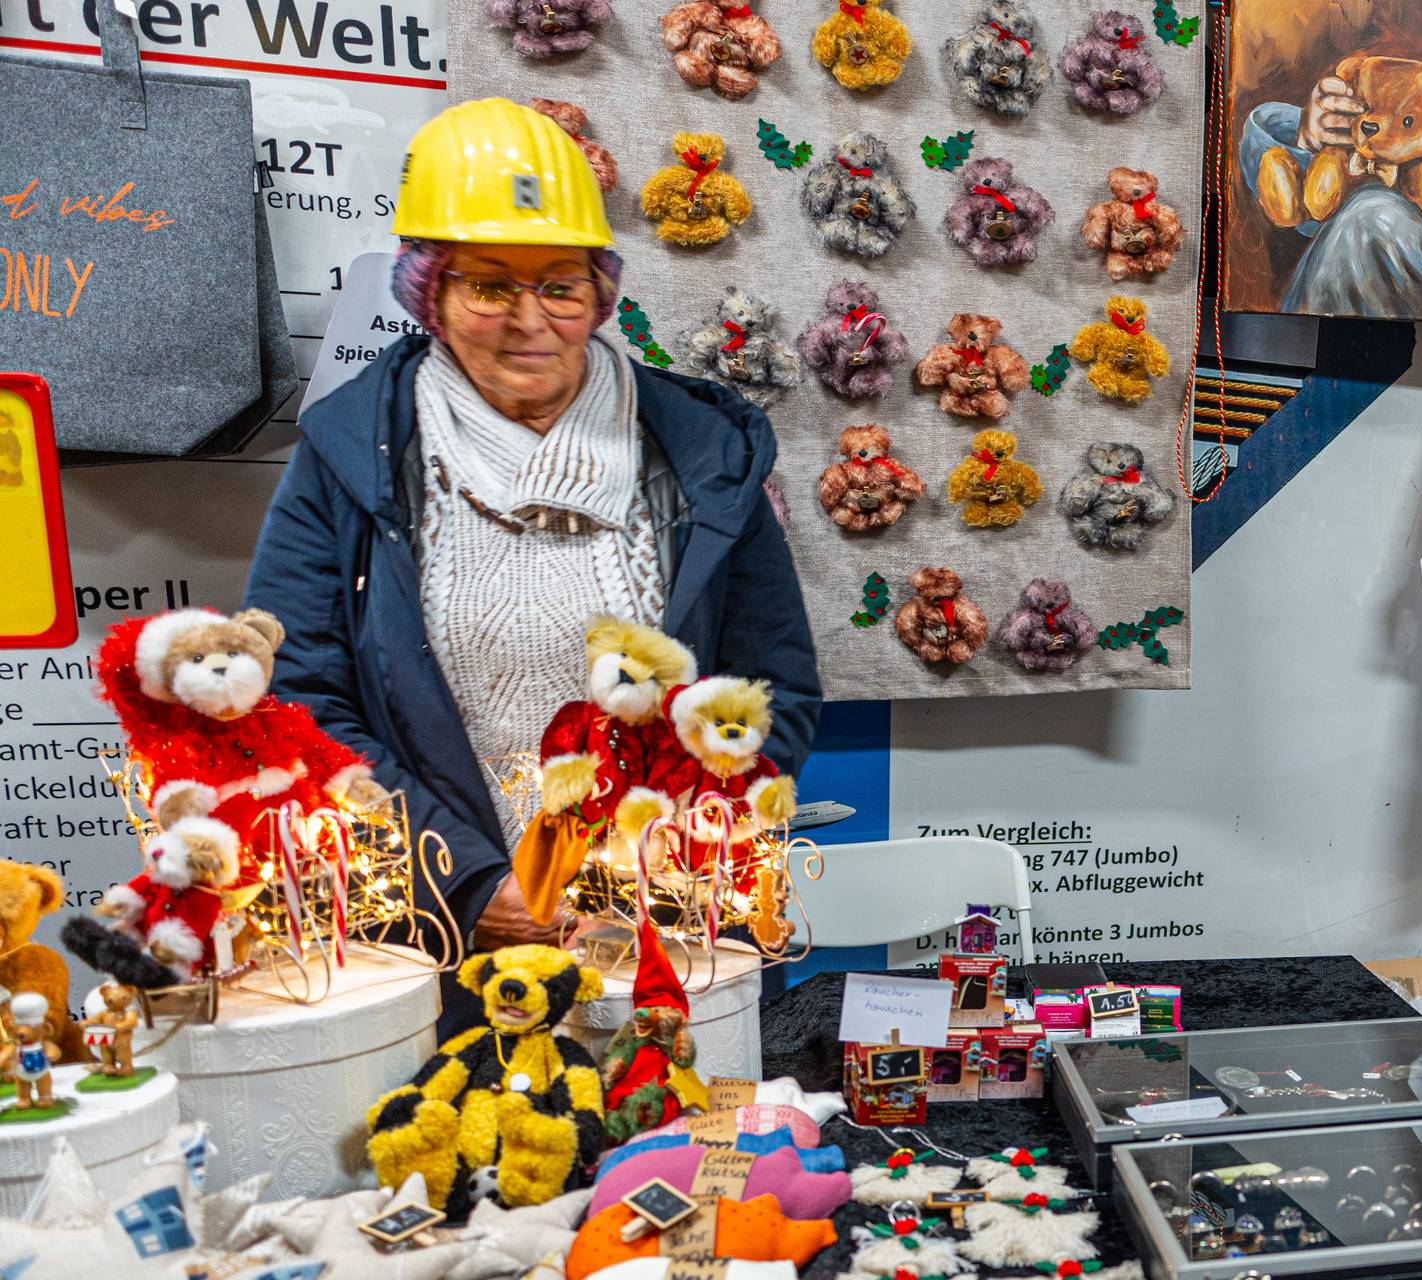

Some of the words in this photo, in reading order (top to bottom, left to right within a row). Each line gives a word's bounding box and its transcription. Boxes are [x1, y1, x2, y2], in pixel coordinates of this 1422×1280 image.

[246, 0, 447, 72] Welt.
[260, 138, 343, 177] 12T
[41, 656, 97, 680] Anl
[977, 821, 1092, 844] Vergleich:
[1051, 849, 1089, 867] 747
[1095, 845, 1178, 869] (Jumbo)
[1056, 870, 1205, 898] Abfluggewicht
[1032, 926, 1103, 944] könnte
[1109, 923, 1121, 941] 3
[1126, 921, 1205, 941] Jumbos
